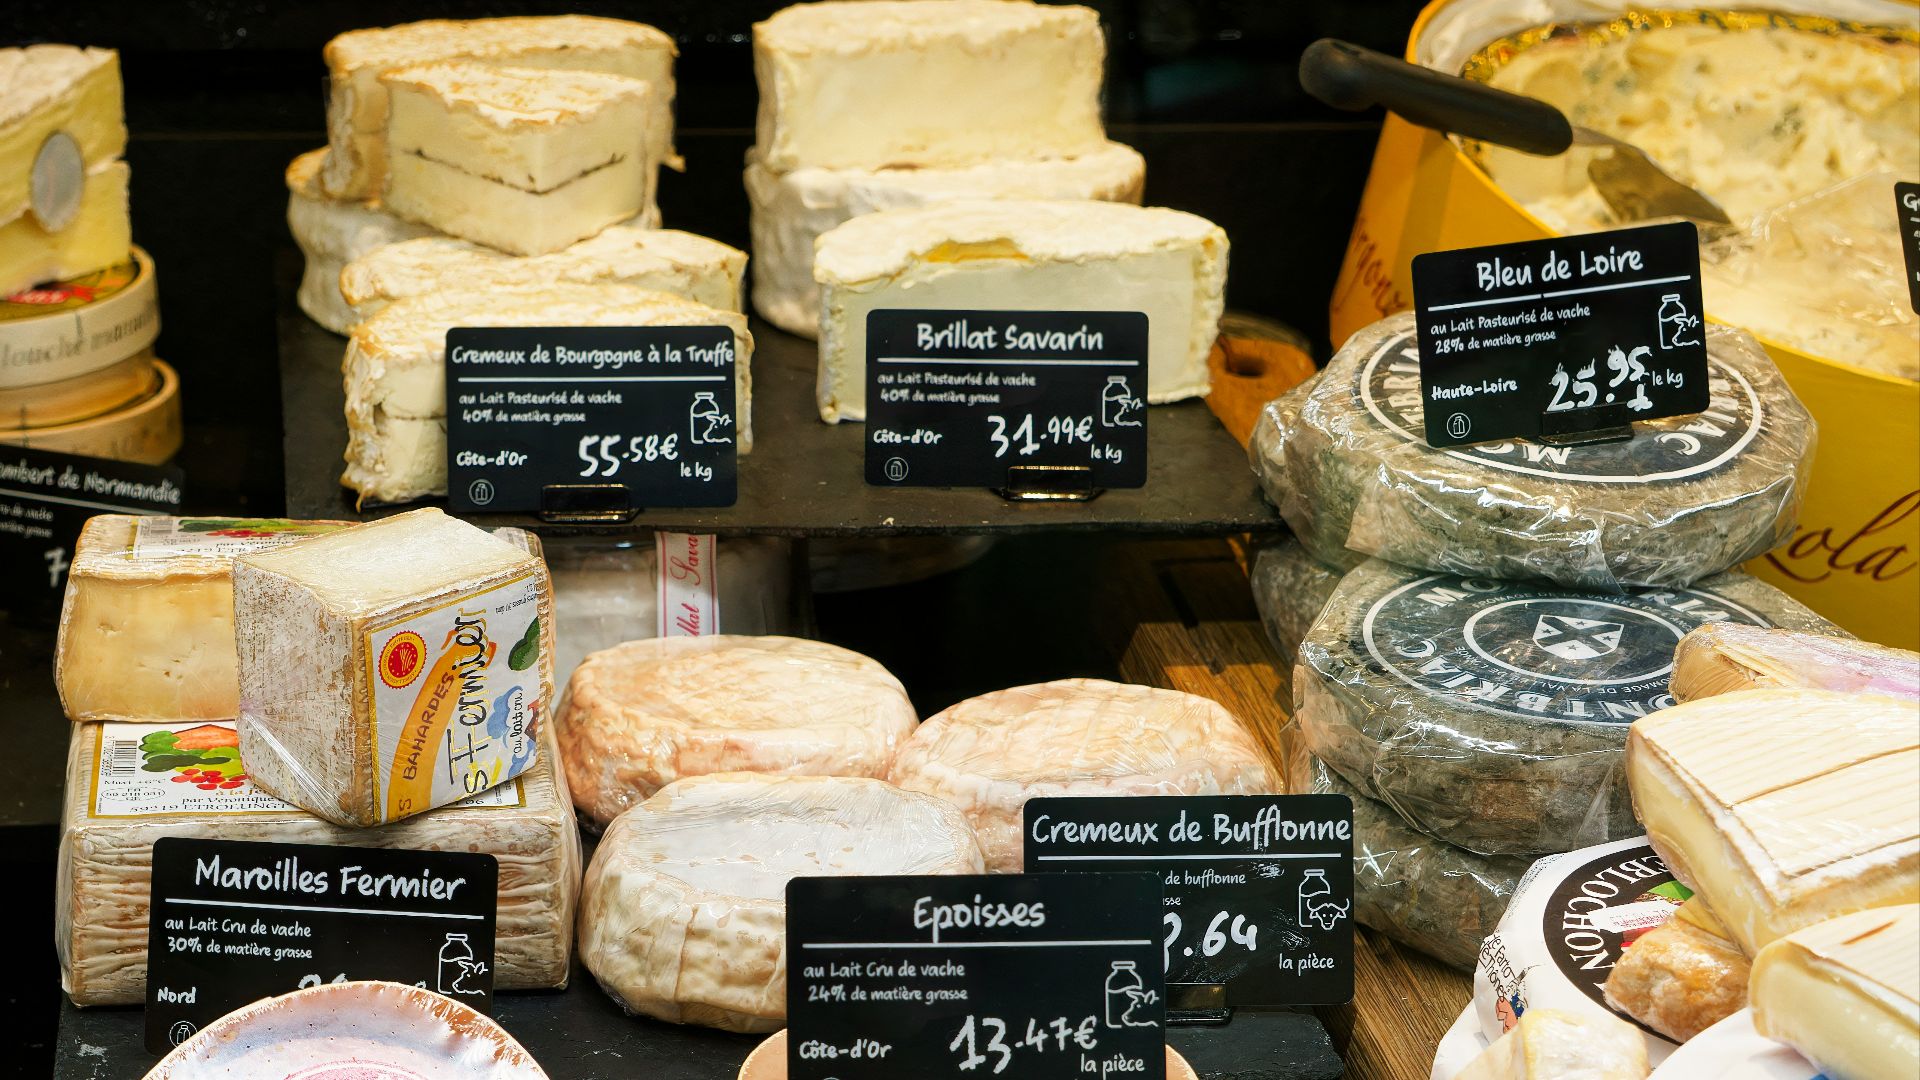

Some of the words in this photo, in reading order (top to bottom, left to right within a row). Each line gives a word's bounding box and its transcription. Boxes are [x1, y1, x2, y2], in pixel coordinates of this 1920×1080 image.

[1476, 257, 1532, 292] Bleu
[1541, 250, 1572, 280] de
[1580, 245, 1643, 276] Loire
[1430, 323, 1447, 335] au
[1450, 319, 1475, 333] Lait
[1478, 310, 1537, 329] Pasteurisé
[1540, 307, 1554, 322] de
[1556, 303, 1591, 319] vache
[917, 319, 997, 351] Brillat
[1004, 324, 1103, 351] Savarin
[1435, 338, 1465, 355] 28%
[1467, 337, 1480, 350] de
[1482, 333, 1522, 348] matière
[1524, 330, 1556, 347] grasse
[452, 346, 525, 364] Cremeux
[530, 344, 551, 363] de
[556, 346, 643, 369] Bourgogne
[648, 344, 660, 363] à
[665, 343, 682, 363] la
[685, 341, 734, 367] Truffe
[877, 374, 893, 384] au
[897, 372, 921, 384] Lait
[924, 372, 982, 385] Pasteurisé
[985, 373, 999, 385] de
[1002, 374, 1036, 386] vache
[1431, 378, 1518, 400] Haute-Loire
[1652, 370, 1663, 387] le
[1667, 370, 1683, 388] kg
[459, 394, 475, 404] au
[479, 392, 504, 404] Lait
[508, 391, 567, 405] Pasteurisé
[570, 393, 585, 404] de
[588, 391, 623, 404] vache
[880, 389, 910, 402] 40%
[912, 390, 925, 402] de
[927, 390, 965, 403] matière
[967, 392, 1000, 407] grasse
[462, 410, 493, 423] 40%
[495, 410, 508, 422] de
[511, 409, 550, 422] matière
[553, 411, 586, 426] grasse
[874, 428, 943, 444] Côte-d'Or
[987, 413, 1093, 458] 31.99€
[456, 450, 528, 467] Côte-d'Or
[579, 433, 678, 478] 55.58€
[1090, 444, 1101, 460] le
[1105, 444, 1122, 464] kg
[680, 462, 692, 478] le
[695, 462, 712, 481] kg
[58, 464, 80, 490] de
[84, 472, 181, 504] Normandie
[670, 535, 700, 586] Sava
[403, 672, 455, 780] BAHARDES
[510, 711, 524, 738] lait
[1032, 814, 1158, 844] Cremeux
[1168, 810, 1202, 842] de
[1213, 804, 1350, 850] Bufflonne
[195, 854, 329, 894] Maroilles
[340, 866, 466, 900] Fermier
[1165, 872, 1180, 885] de
[1185, 869, 1246, 889] bufflonne
[913, 895, 1046, 943] Epoisses
[1563, 855, 1670, 970] EBLOCHON
[165, 919, 183, 930] au
[189, 917, 218, 932] Lait
[222, 919, 246, 933] Cru
[251, 920, 267, 935] de
[271, 924, 311, 937] vache
[167, 938, 202, 953] 30%
[206, 940, 221, 953] de
[224, 942, 271, 957] matière
[274, 947, 312, 961] grasse
[804, 966, 824, 978] au
[830, 962, 863, 978] Lait
[867, 962, 895, 977] Cru
[898, 961, 916, 977] de
[921, 962, 965, 977] vache
[1279, 953, 1293, 970] la
[1298, 952, 1335, 976] pièce
[157, 987, 196, 1004] Nord
[808, 986, 846, 1002] 24%
[851, 987, 867, 1001] de
[871, 986, 922, 1001] matière
[925, 988, 968, 1005] grasse
[800, 1038, 892, 1059] Côte-d'Or
[949, 1015, 1097, 1075] 13.47€
[1081, 1054, 1096, 1073] la
[1103, 1053, 1145, 1080] pièce
